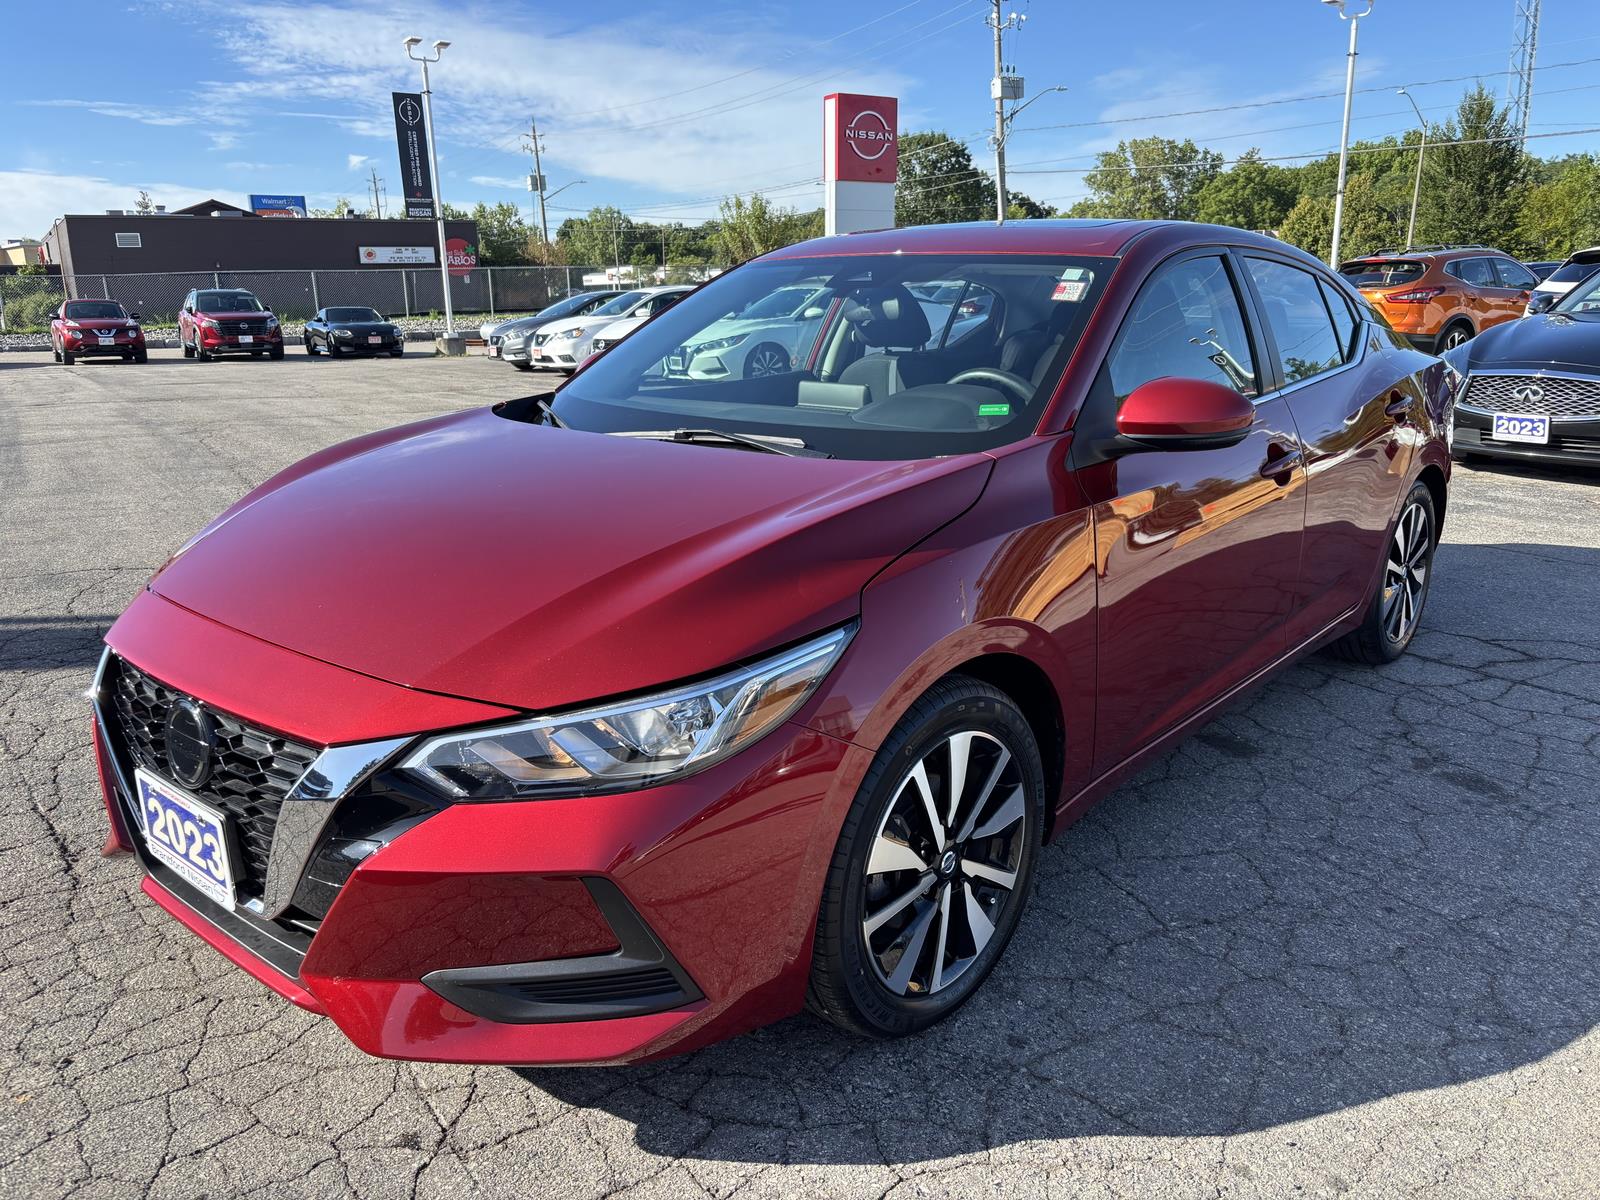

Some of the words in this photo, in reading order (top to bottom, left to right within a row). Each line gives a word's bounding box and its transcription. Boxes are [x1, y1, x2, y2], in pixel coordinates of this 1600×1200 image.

[845, 129, 893, 141] NISSAN
[447, 255, 477, 266] ARIOS
[1496, 419, 1545, 437] 2023
[148, 797, 225, 881] 2023
